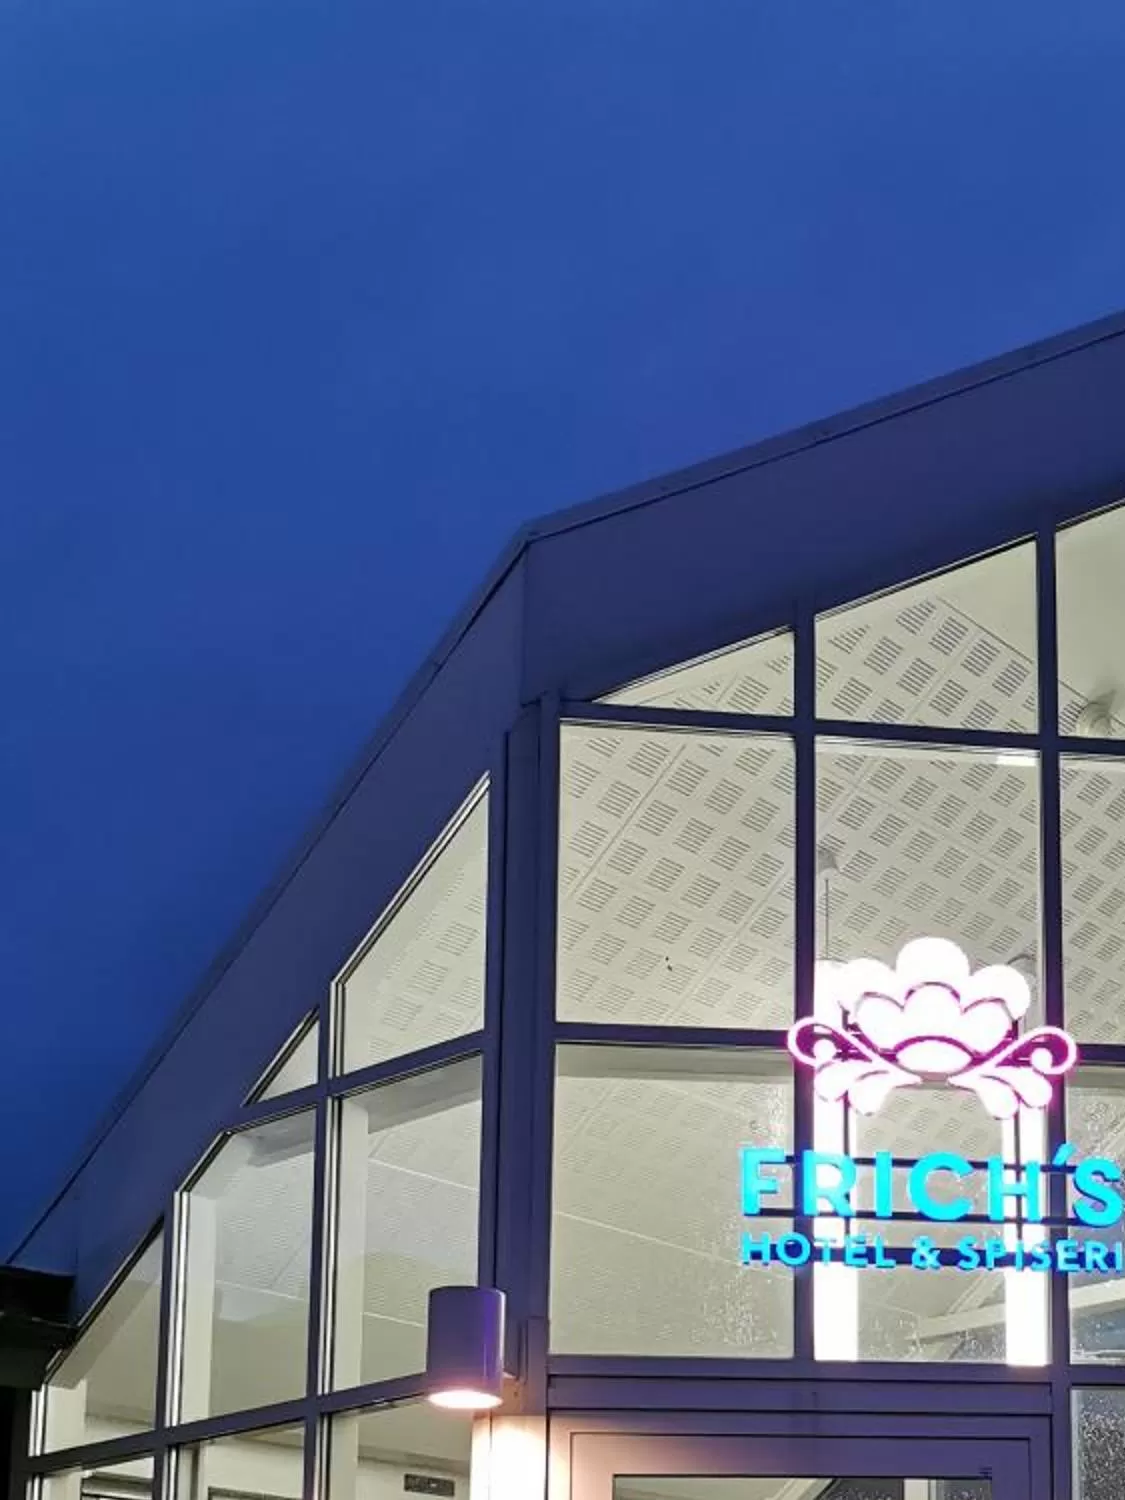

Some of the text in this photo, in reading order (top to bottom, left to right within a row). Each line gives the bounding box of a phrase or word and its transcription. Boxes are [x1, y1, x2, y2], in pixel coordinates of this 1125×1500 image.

[739, 1142, 1125, 1227] FRICH'S
[741, 1232, 1125, 1273] HOTEL & SPISERI
